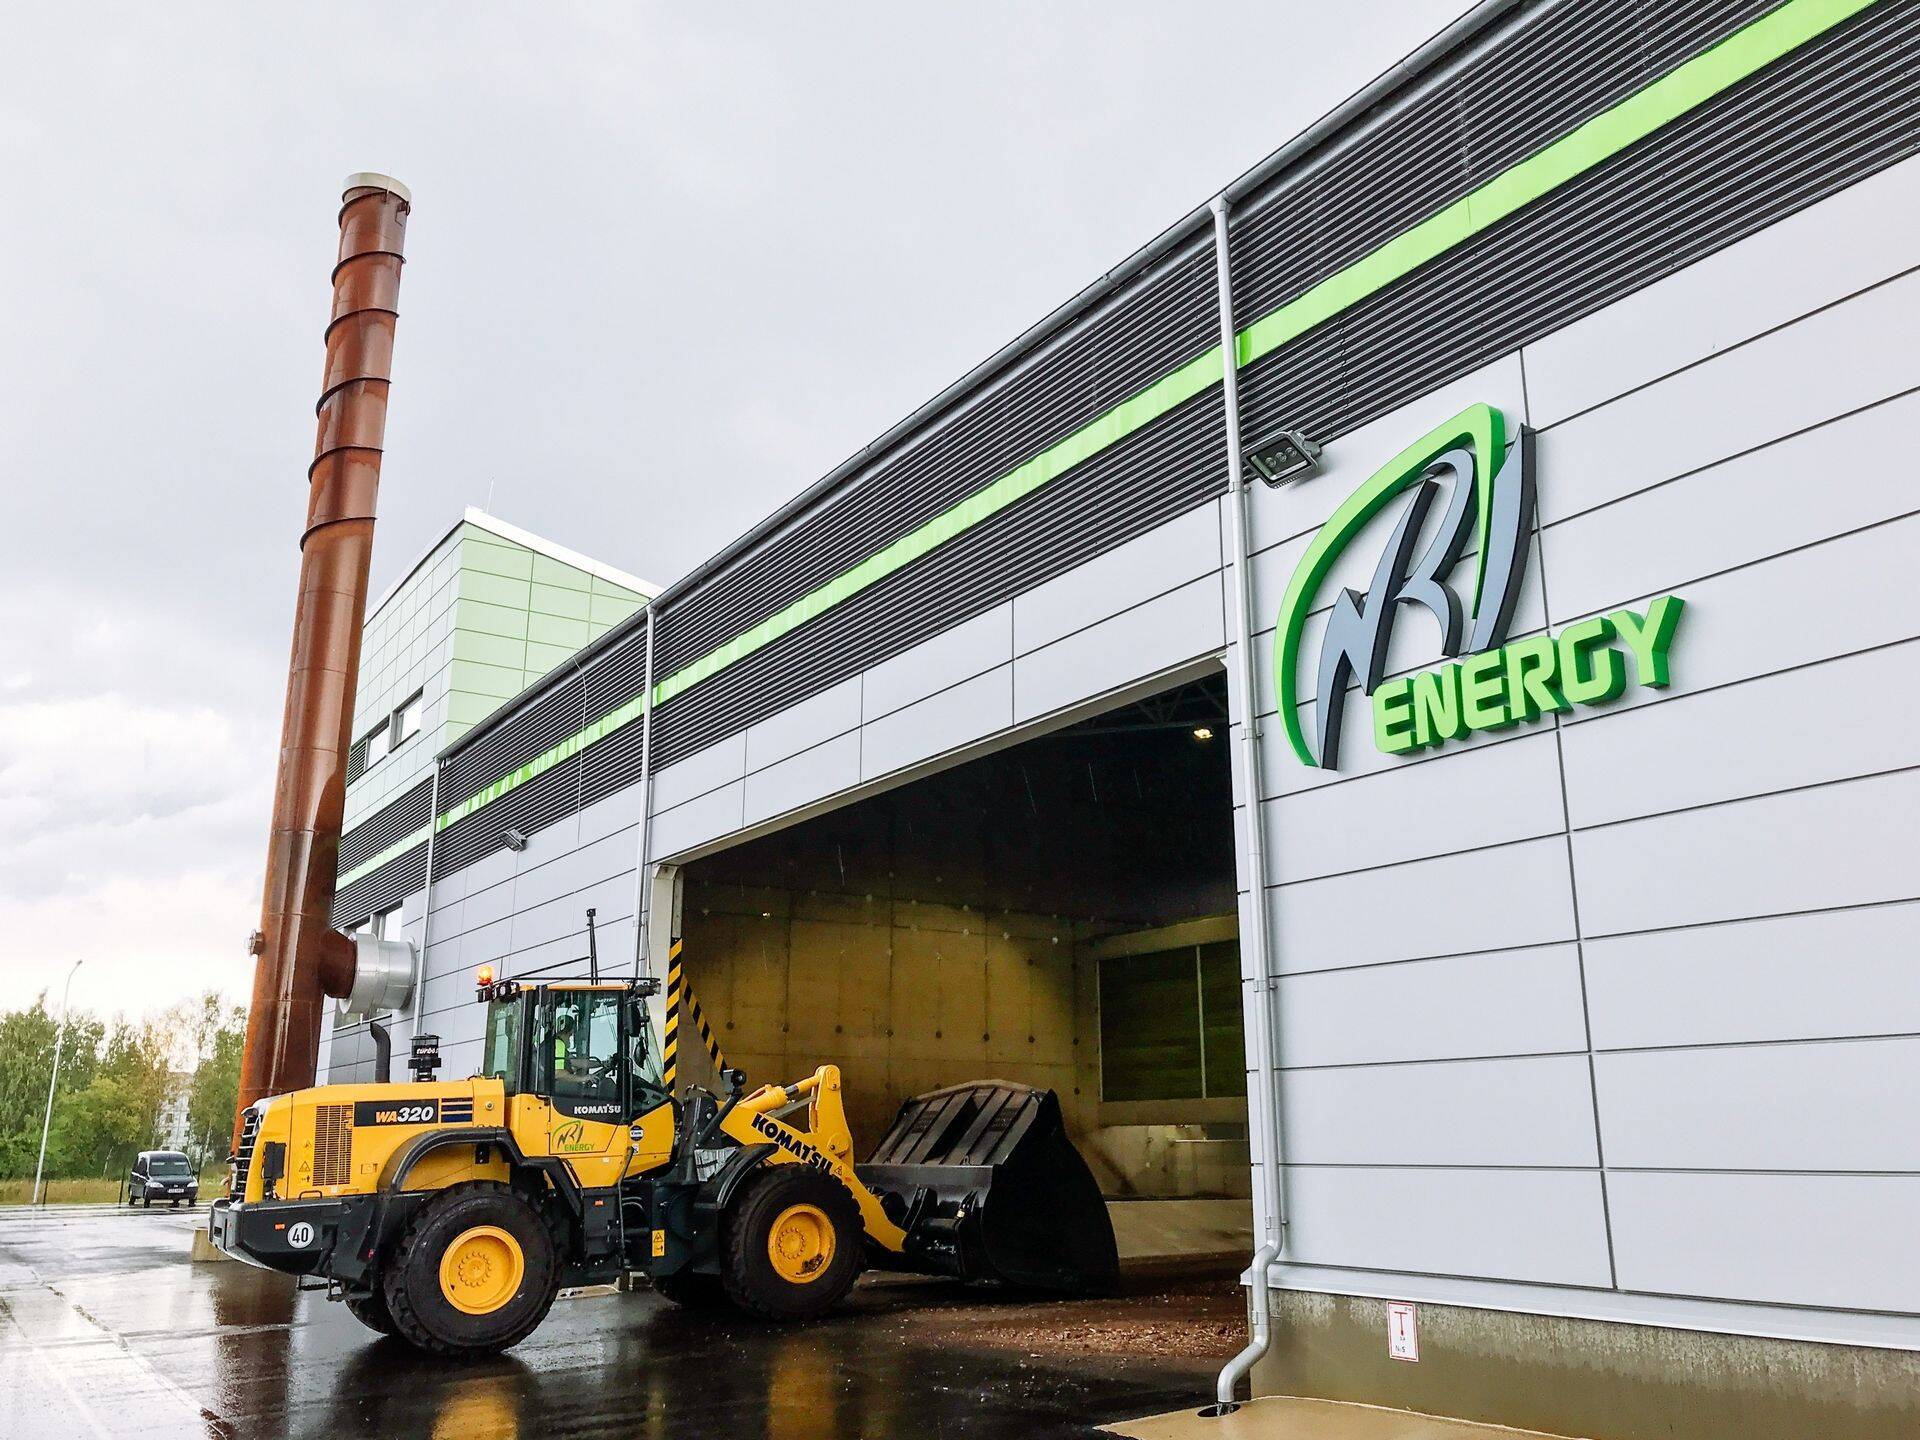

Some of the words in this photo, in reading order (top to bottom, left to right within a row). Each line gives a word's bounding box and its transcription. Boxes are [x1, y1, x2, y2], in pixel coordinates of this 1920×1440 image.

[1373, 594, 1686, 755] ENERGY
[375, 1106, 434, 1123] WA320
[573, 1103, 622, 1115] KOMATSU
[564, 1143, 595, 1152] ENERGY
[751, 1113, 833, 1176] KOMATSU
[292, 1227, 309, 1243] 40
